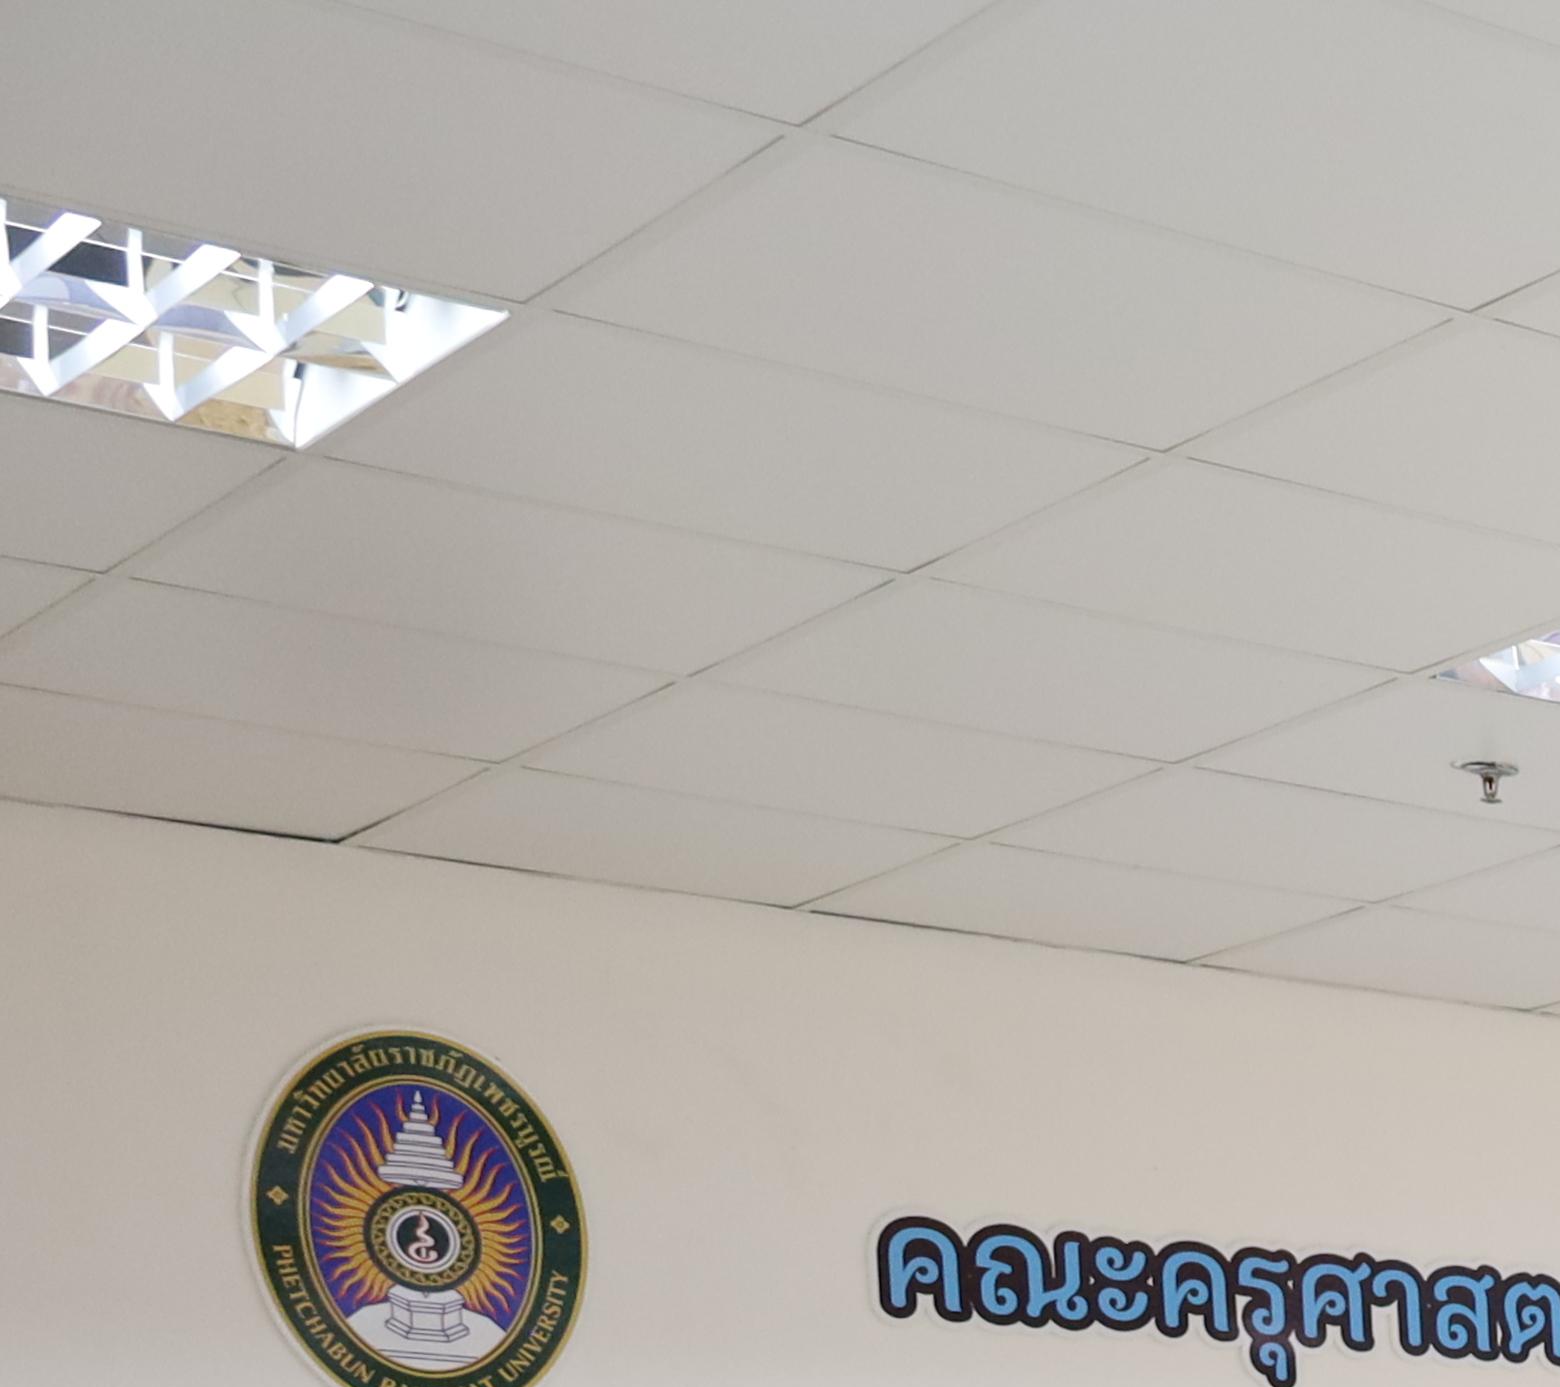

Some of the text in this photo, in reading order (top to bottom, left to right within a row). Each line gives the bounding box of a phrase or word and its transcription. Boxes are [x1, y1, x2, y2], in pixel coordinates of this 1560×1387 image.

[277, 1044, 571, 1183] มหาวิทยาลัยราชภัฏเพชรบูรณ์
[272, 1243, 375, 1385] PHETCHABUN
[498, 1270, 571, 1384] UNIVERSITY
